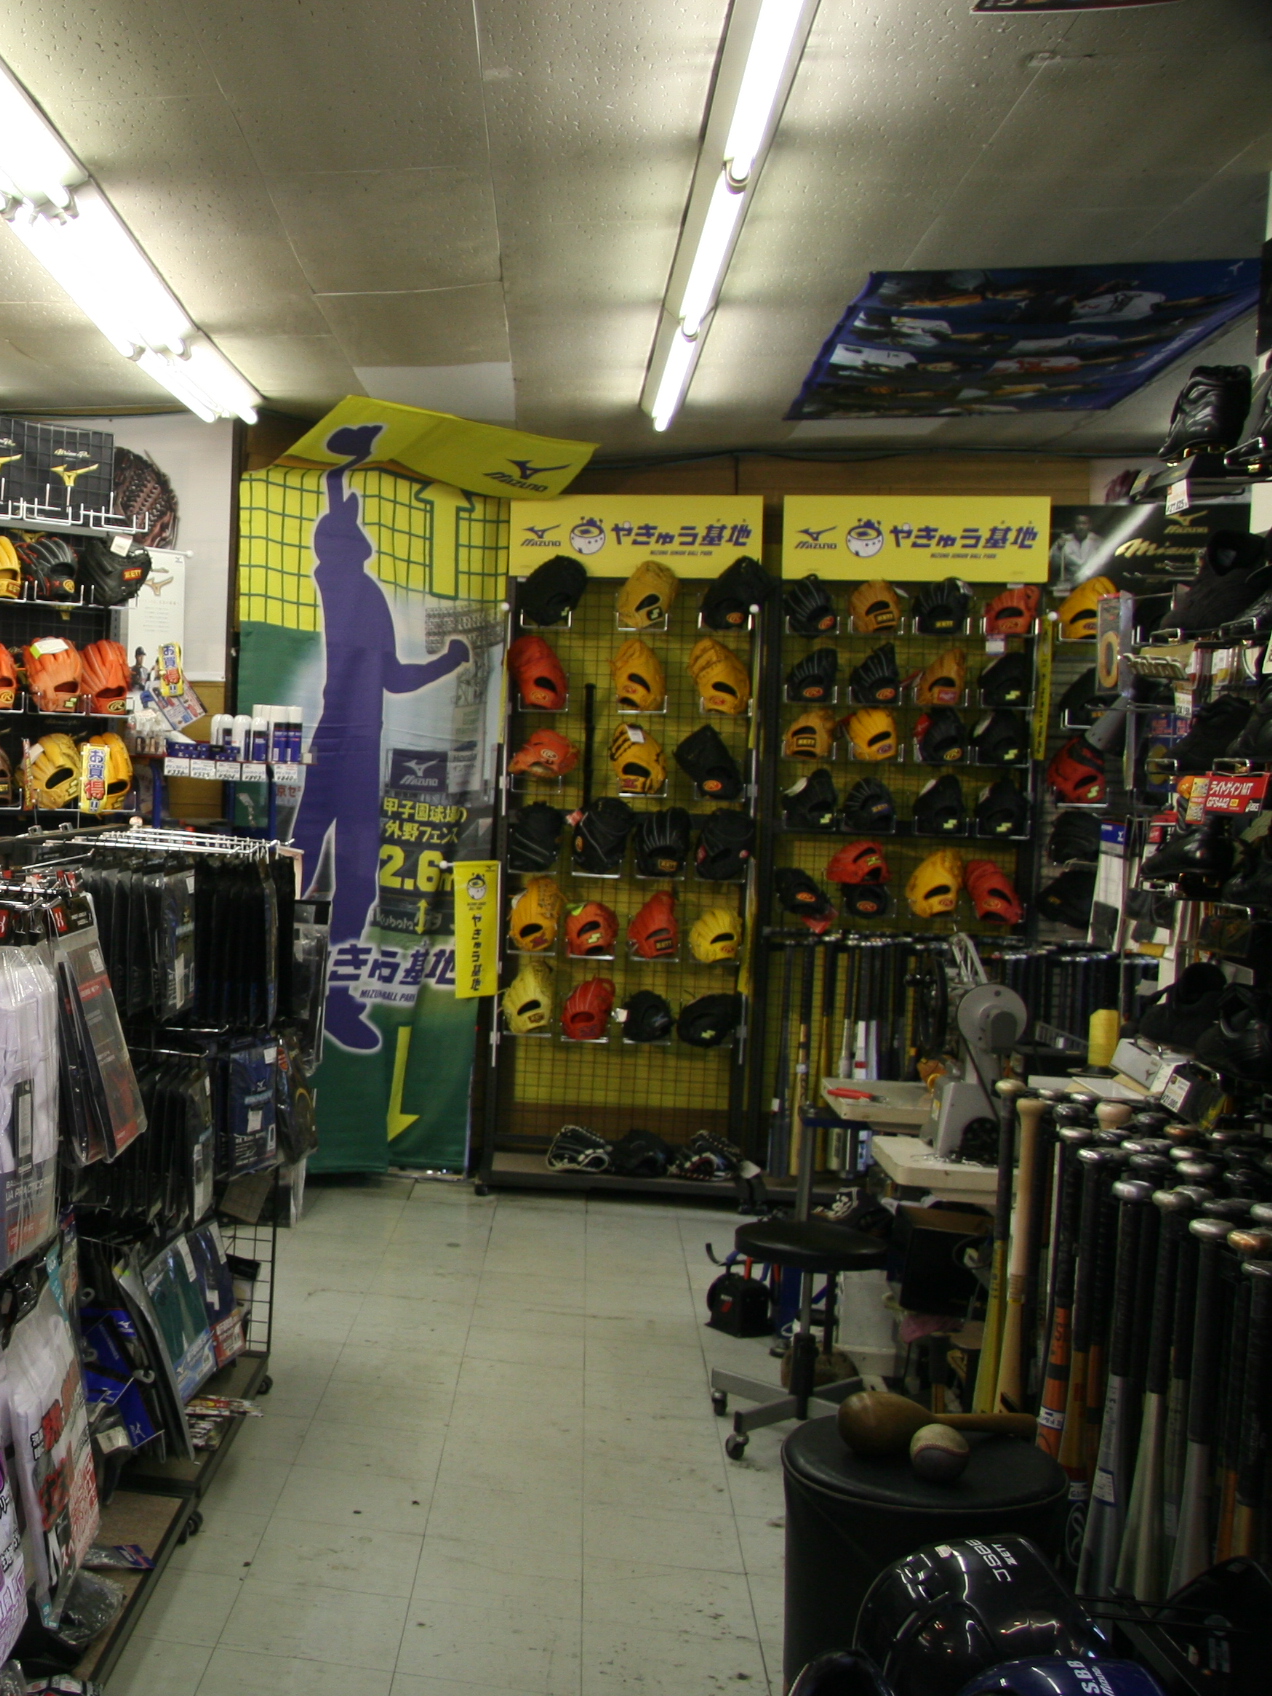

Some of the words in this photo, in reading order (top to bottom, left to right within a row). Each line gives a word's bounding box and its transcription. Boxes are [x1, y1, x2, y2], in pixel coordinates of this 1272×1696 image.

[611, 523, 752, 547] やきゅう基地
[890, 525, 1038, 550] やきゅう基地
[385, 820, 459, 844] 外野フェンス
